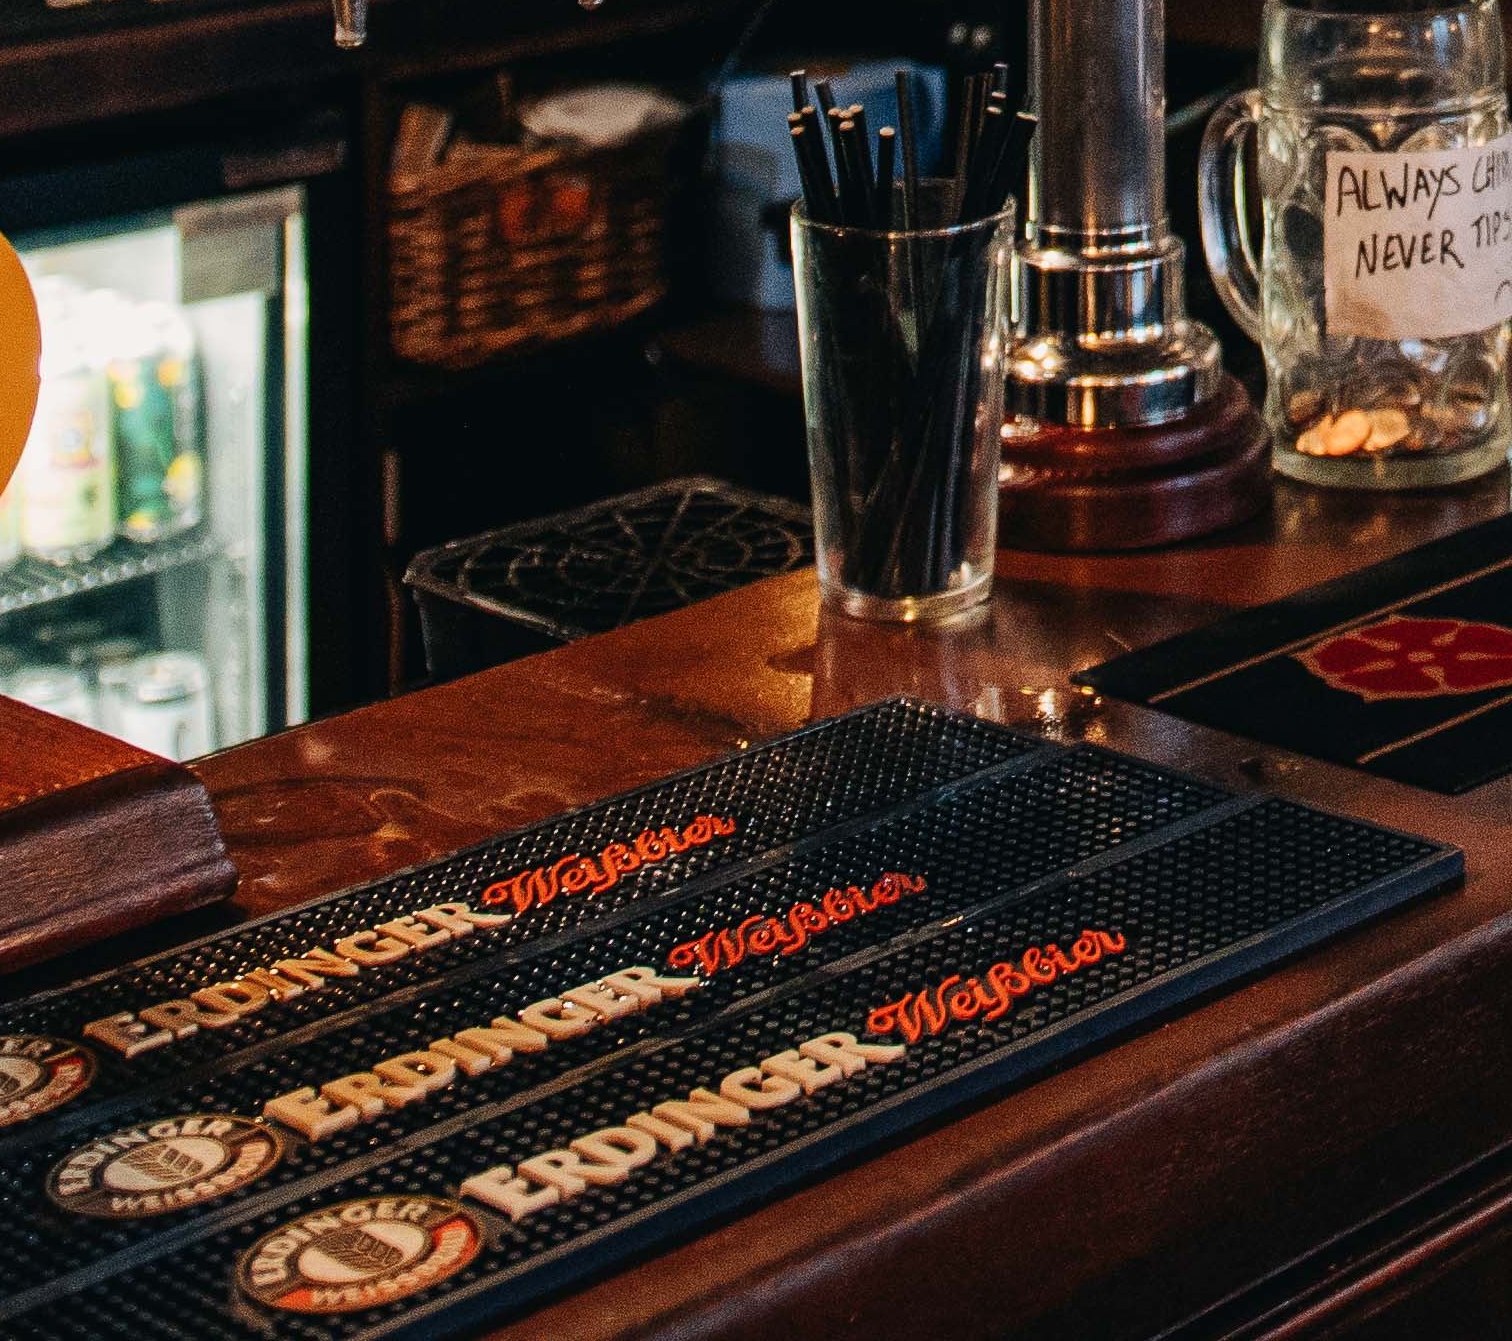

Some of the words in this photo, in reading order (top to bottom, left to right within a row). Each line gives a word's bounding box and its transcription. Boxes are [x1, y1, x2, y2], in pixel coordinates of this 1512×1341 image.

[1336, 162, 1462, 220] ALWAYS
[1354, 229, 1465, 279] NEVER
[84, 901, 514, 1060] ERDINGER
[483, 815, 736, 919] Weißbier
[262, 961, 702, 1143] ERDINGER
[670, 869, 929, 980] Weißbier
[461, 1028, 906, 1223] ERDINGER
[866, 927, 1127, 1045] Weißbier
